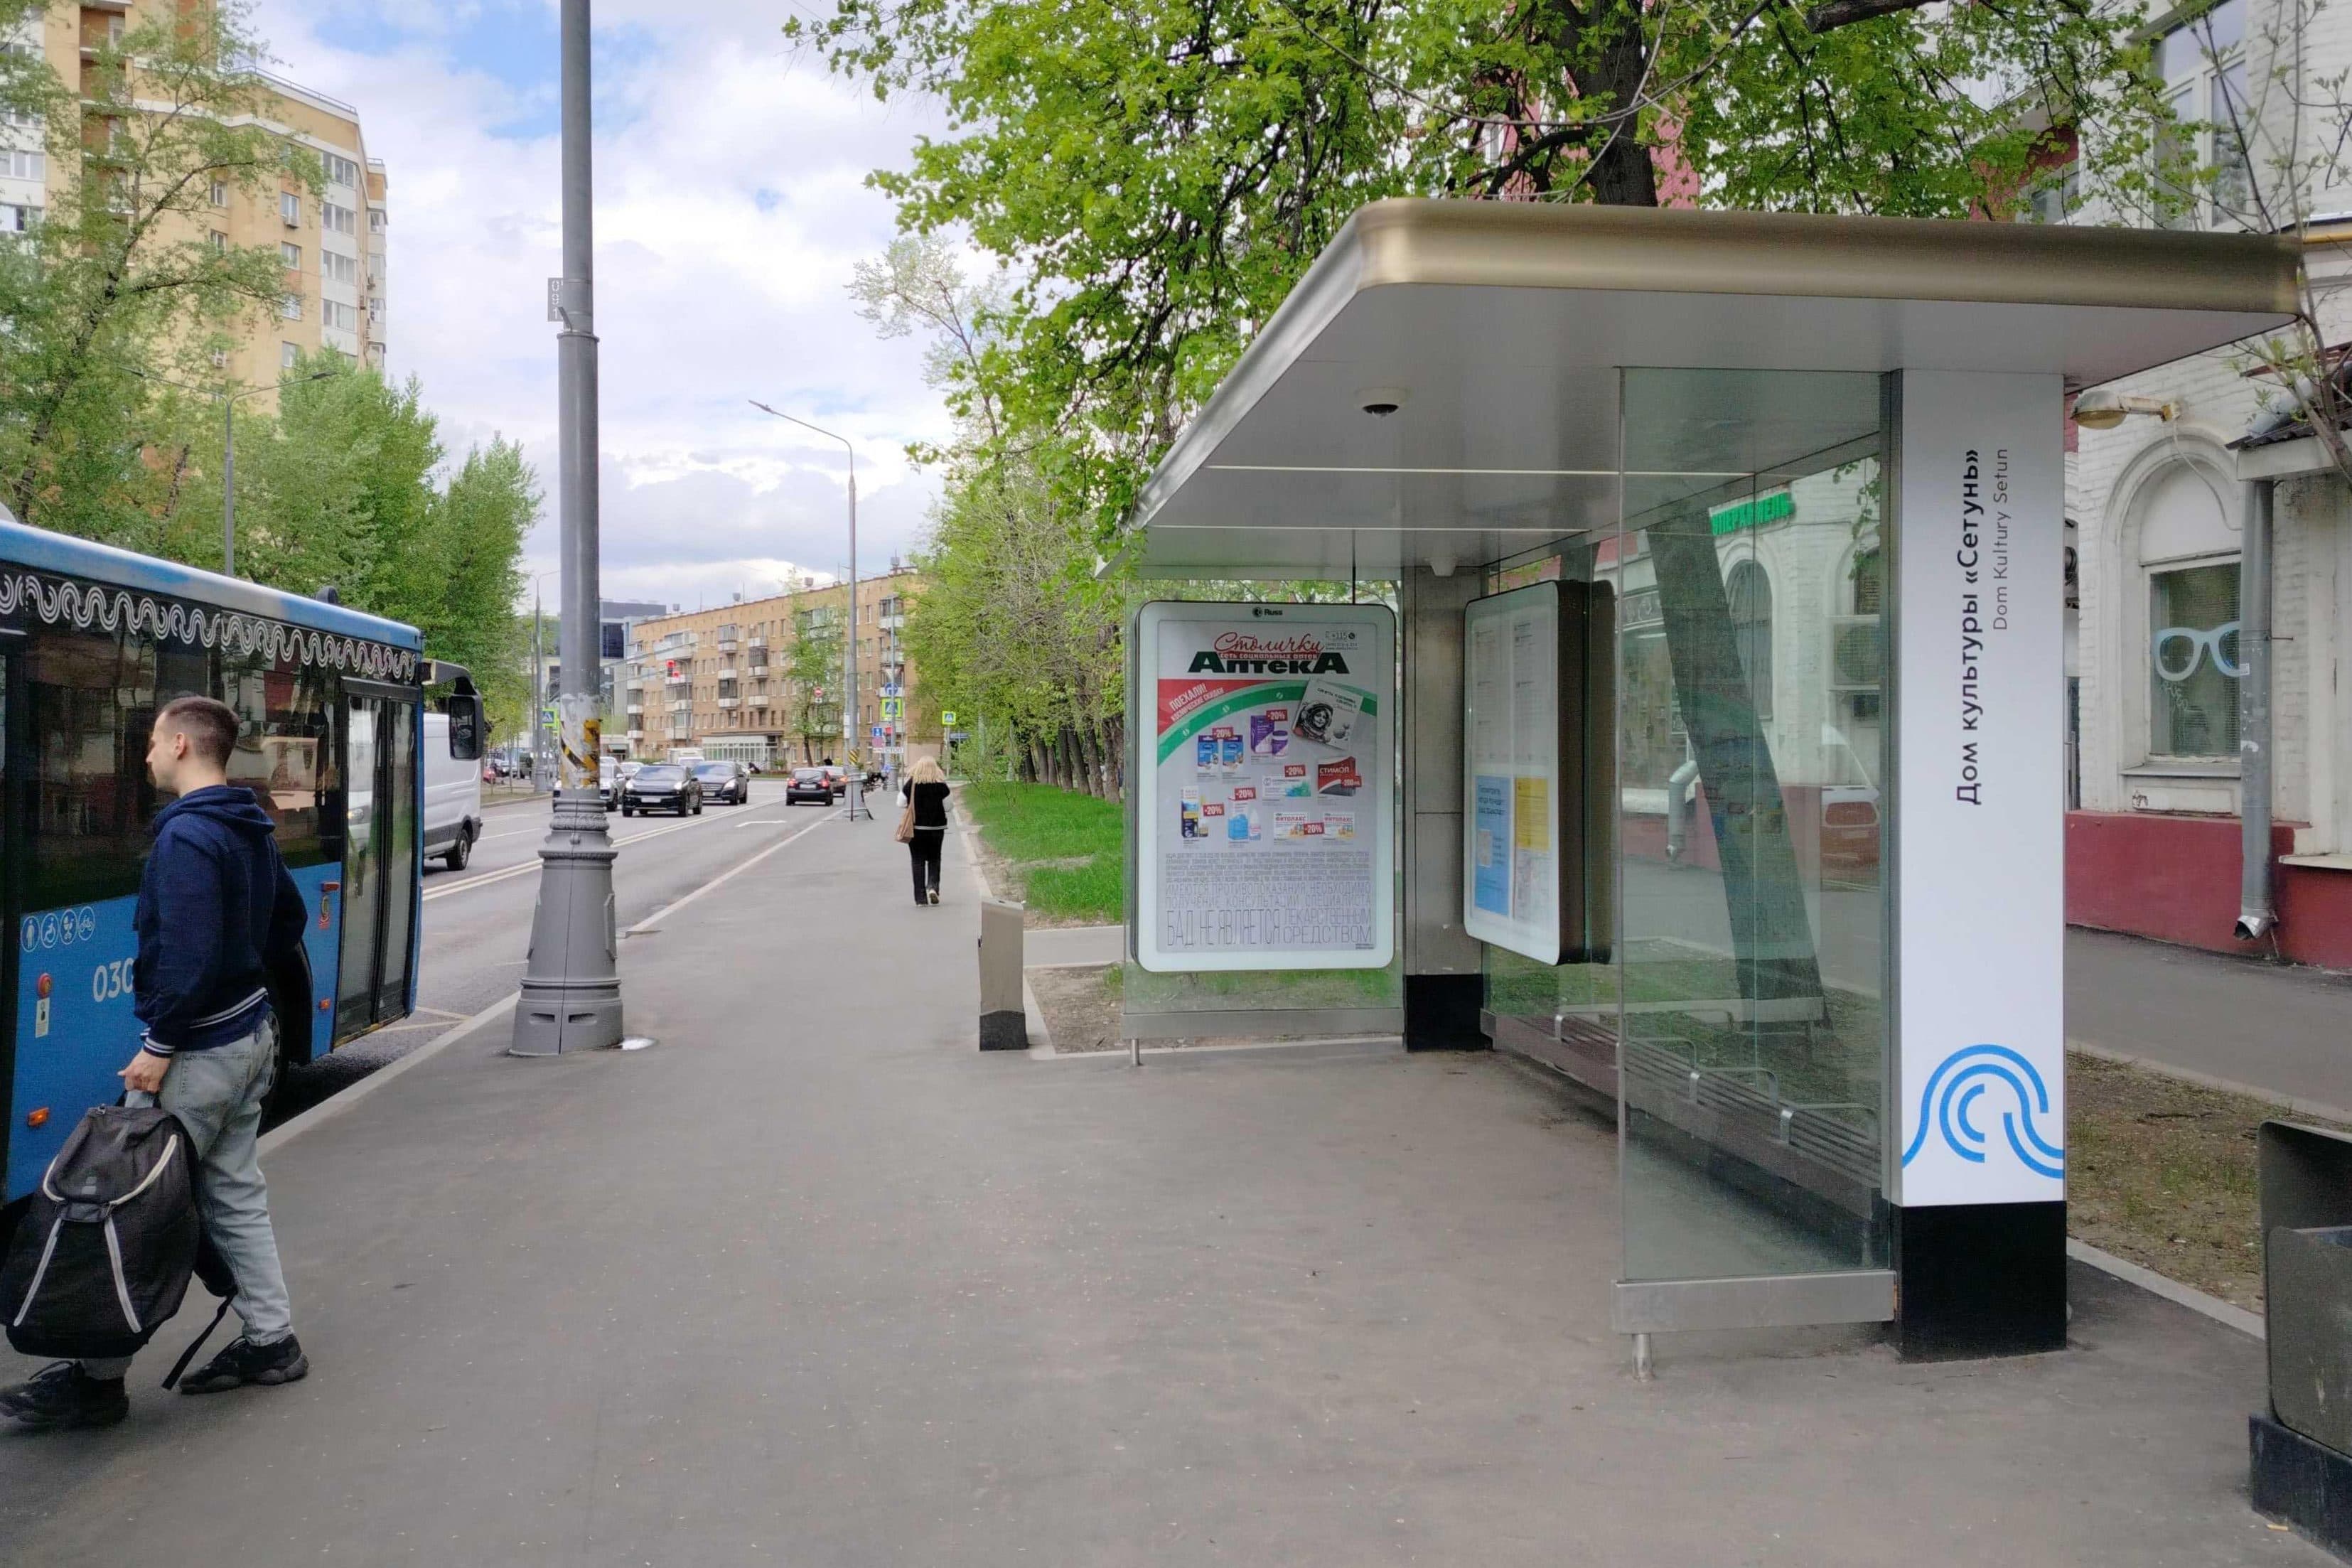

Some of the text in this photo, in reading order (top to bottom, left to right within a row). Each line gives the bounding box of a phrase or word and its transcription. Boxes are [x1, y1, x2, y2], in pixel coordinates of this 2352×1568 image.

[1993, 449, 2012, 630] Dom Kultury Setun
[1214, 631, 1326, 653] Столички
[1957, 449, 1984, 805] Дом культуры «Сетунь»
[1169, 682, 1208, 711] ПОЕХАЛИ!
[1166, 910, 1194, 946] БАД
[1199, 910, 1214, 945] НЕ
[1218, 909, 1280, 945] ЯВЛЯЕТСЯ
[1284, 925, 1371, 945] СРЕДСТВОМ
